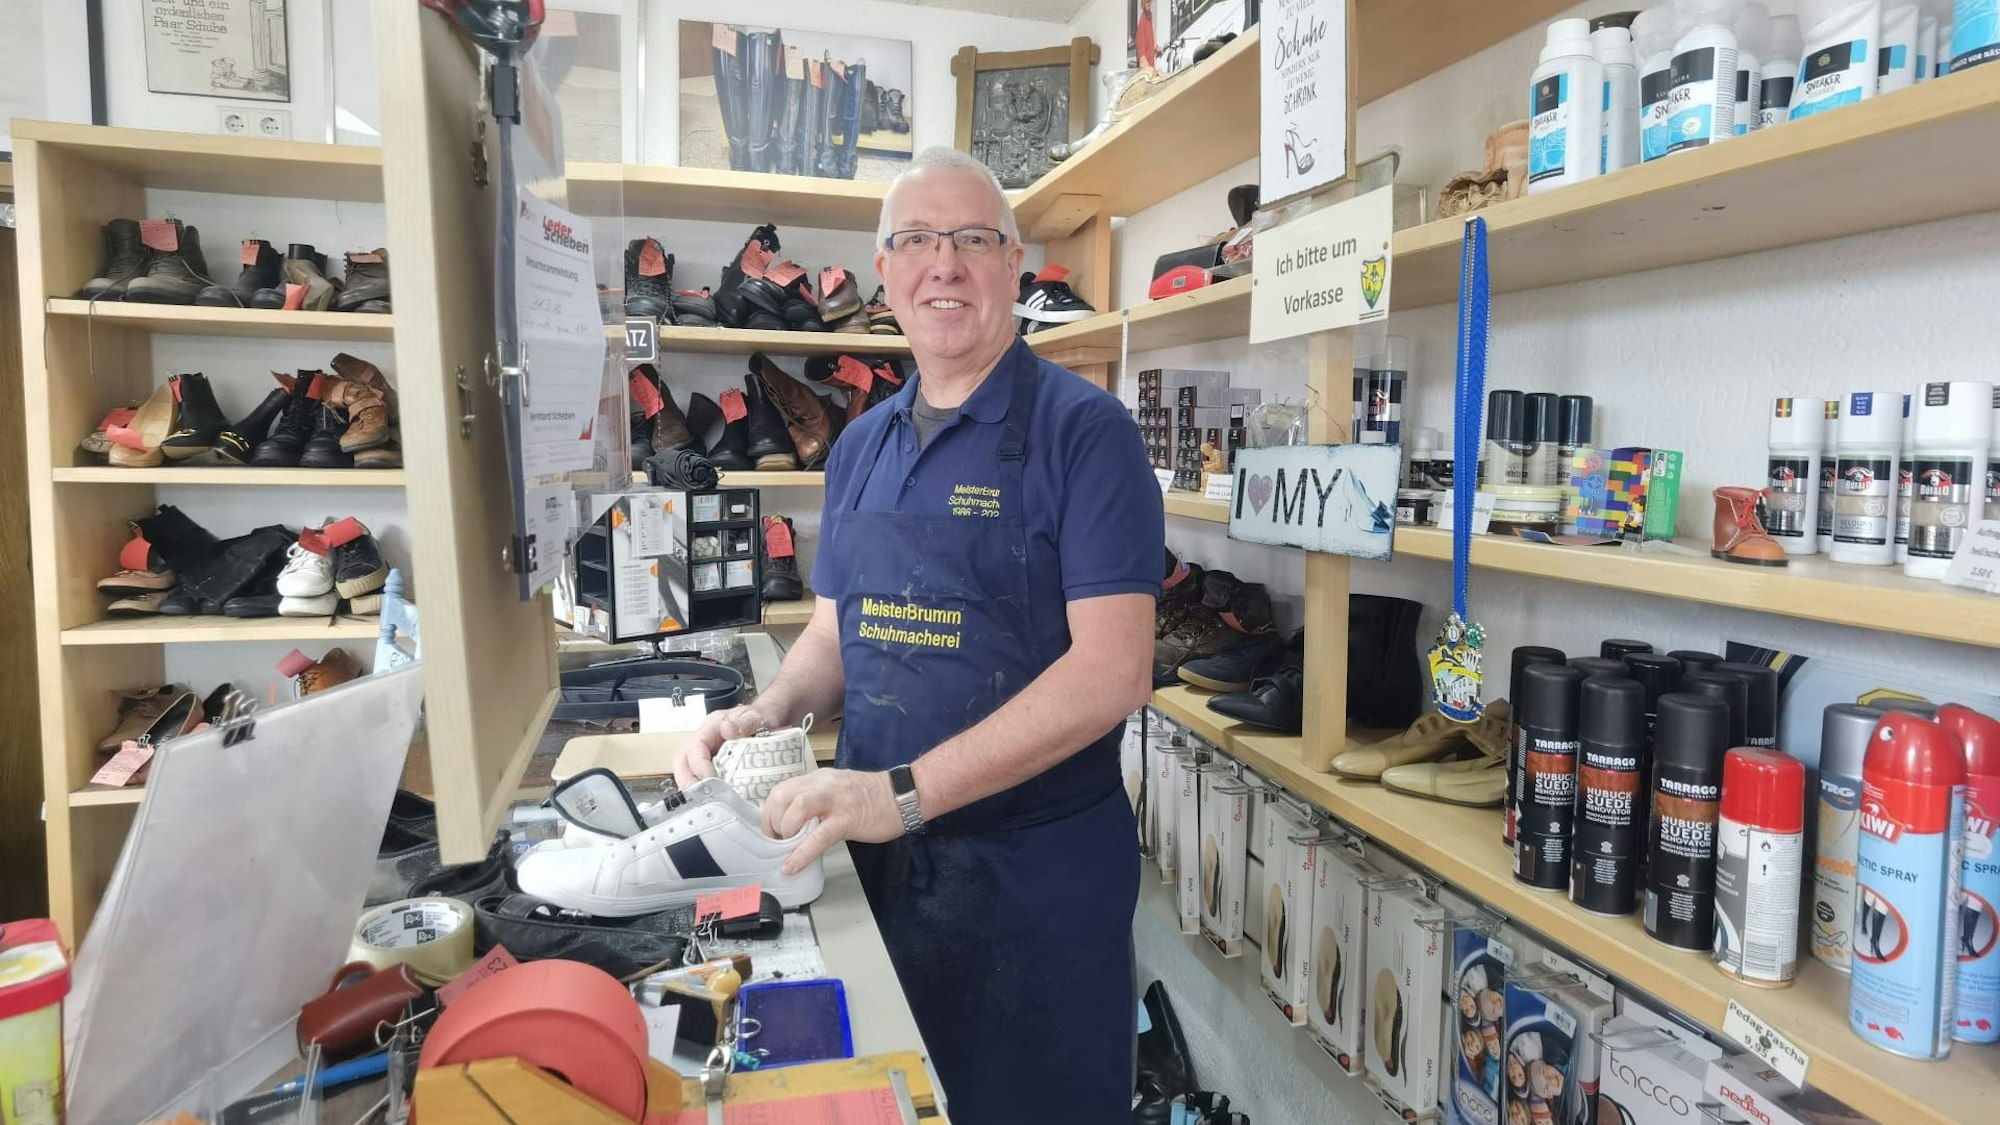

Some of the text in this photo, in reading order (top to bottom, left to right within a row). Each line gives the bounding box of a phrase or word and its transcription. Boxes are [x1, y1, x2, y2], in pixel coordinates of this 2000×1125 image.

[155, 6, 225, 22] ordentliches
[208, 0, 231, 10] ein
[153, 15, 228, 34] Paar Schuhe
[1274, 15, 1327, 71] Schuhe
[1806, 73, 1841, 94] SNEAKER
[1283, 82, 1318, 115] SCHRANK
[543, 215, 572, 238] Leder
[543, 226, 589, 254] Scheben
[1276, 237, 1357, 276] Ich bitte um
[1284, 286, 1344, 315] Vorkasse
[1235, 467, 1343, 528] I MY
[861, 597, 962, 625] MeisterBrumm
[858, 621, 961, 649] Schuhmacherei
[1586, 752, 1637, 767] TARRAGO
[1586, 786, 1633, 800] NUBUCK
[1660, 777, 1718, 795] TARRAGO
[1820, 778, 1856, 798] TRG
[1585, 803, 1632, 816] RENOVATOR
[1586, 794, 1632, 809] SUEDE
[1661, 814, 1712, 831] NUBUCK
[1661, 822, 1712, 841] SUEDE
[1660, 832, 1712, 847] RENOVATOR
[1880, 866, 1920, 884] SPRAY
[1729, 1001, 1806, 1066] Pedag Pascha
[1770, 1056, 1780, 1066] €
[1608, 1050, 1690, 1117] tacco
